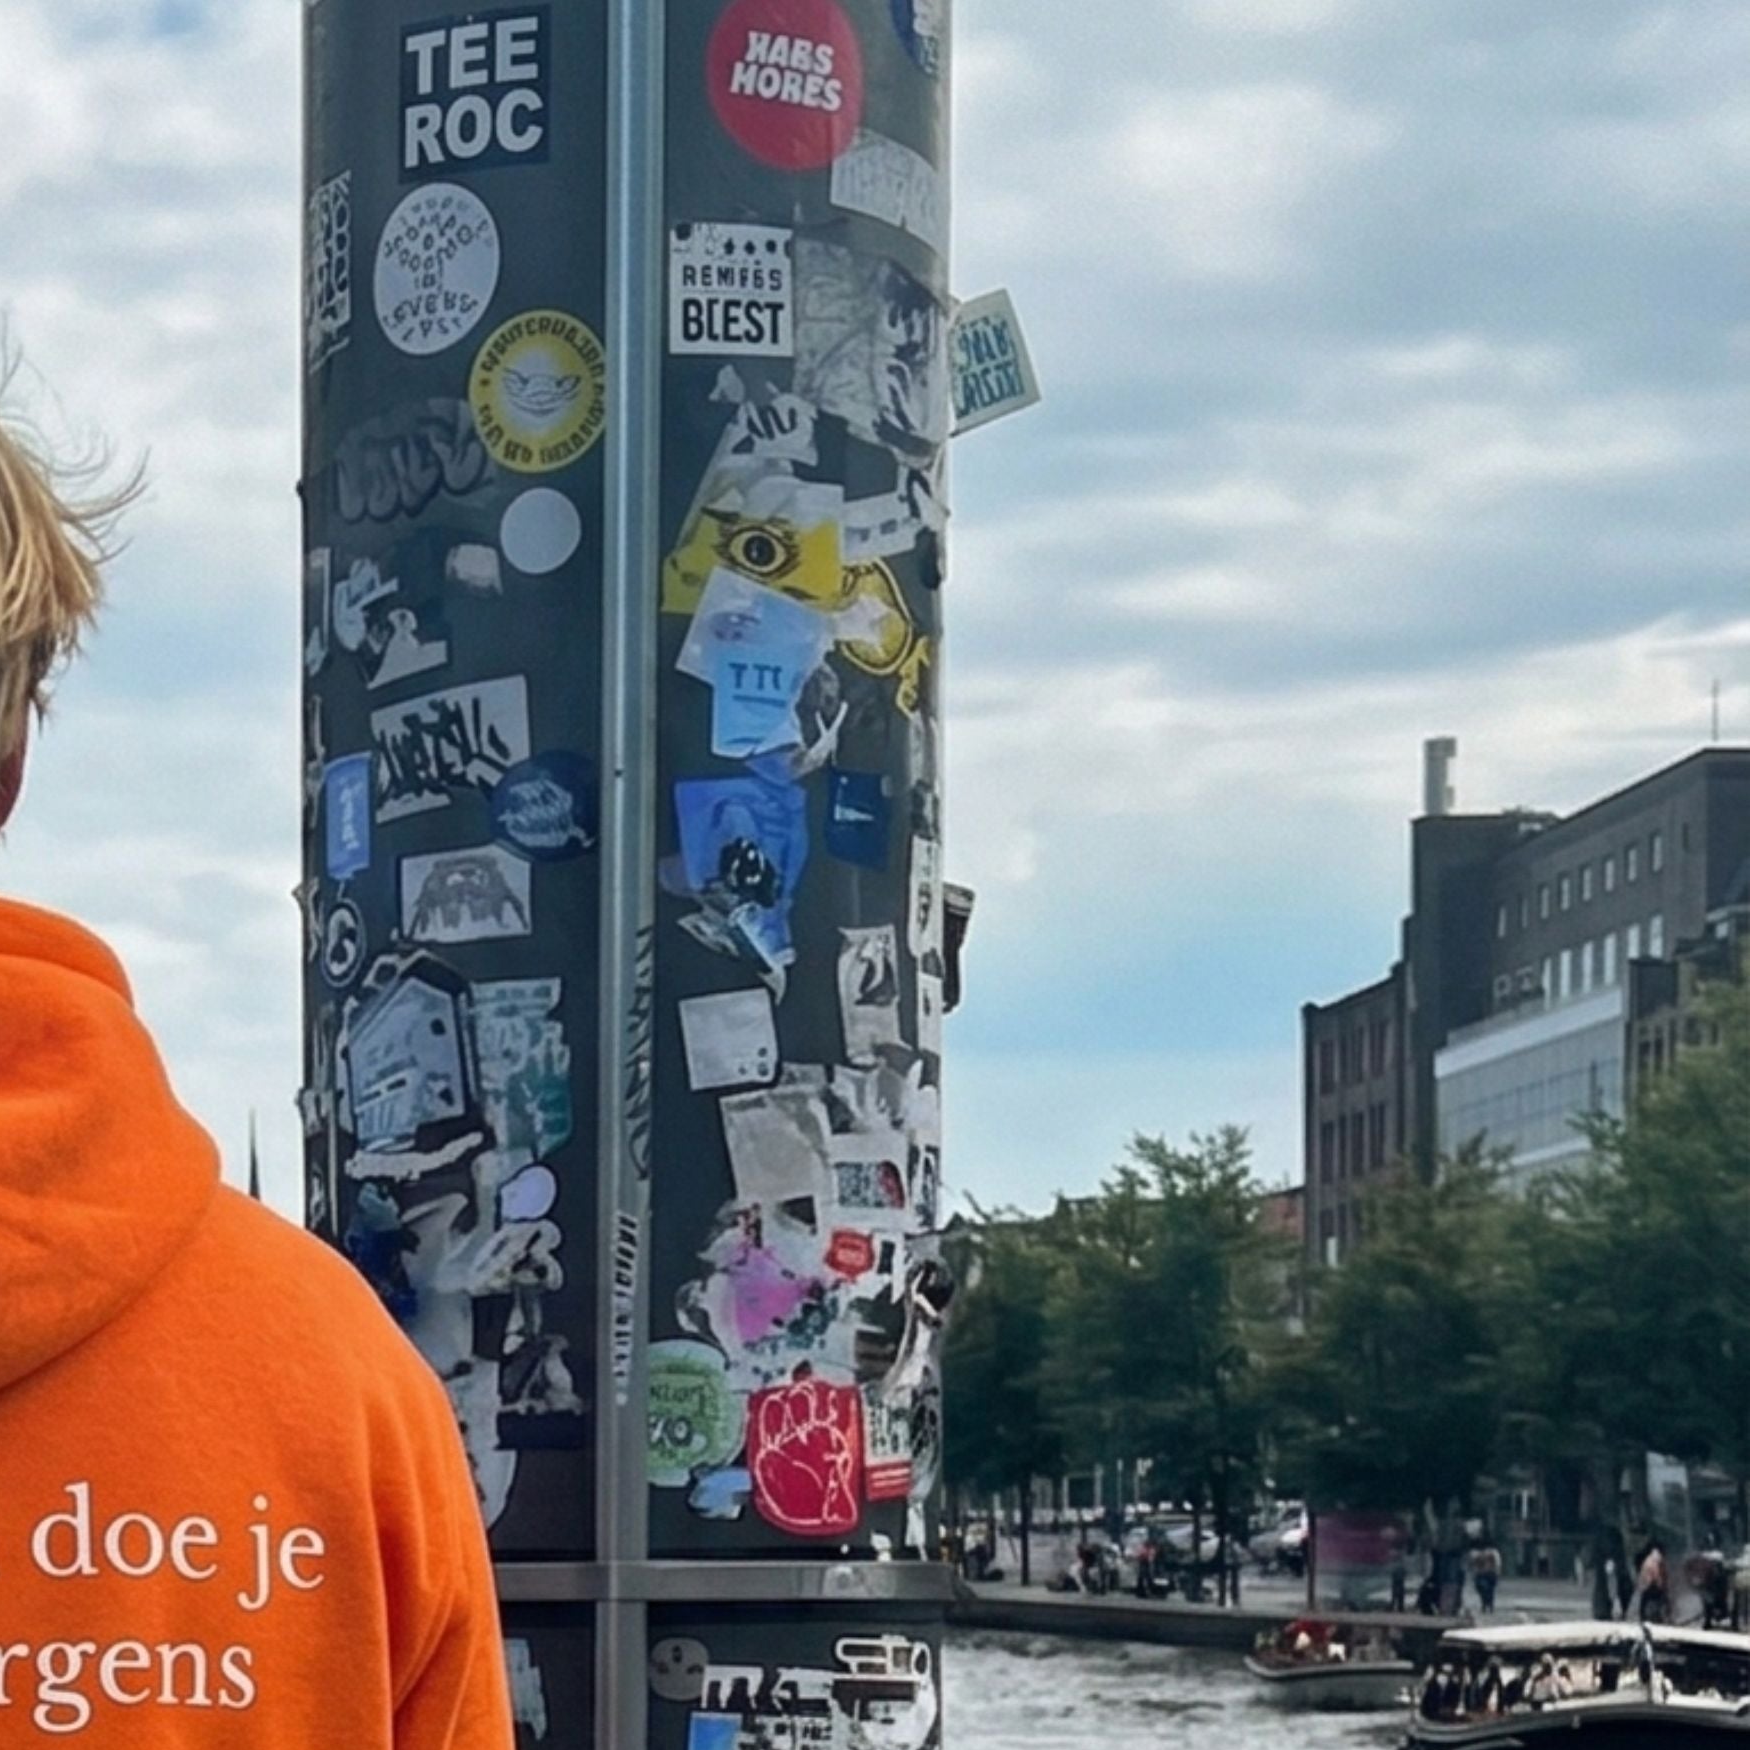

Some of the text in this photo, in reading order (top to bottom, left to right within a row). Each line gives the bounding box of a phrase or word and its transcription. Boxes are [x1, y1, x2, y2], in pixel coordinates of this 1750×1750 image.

[405, 16, 539, 95] TEE
[404, 87, 544, 169] ROC
[31, 1482, 218, 1579] doe
[237, 1495, 326, 1610] je
